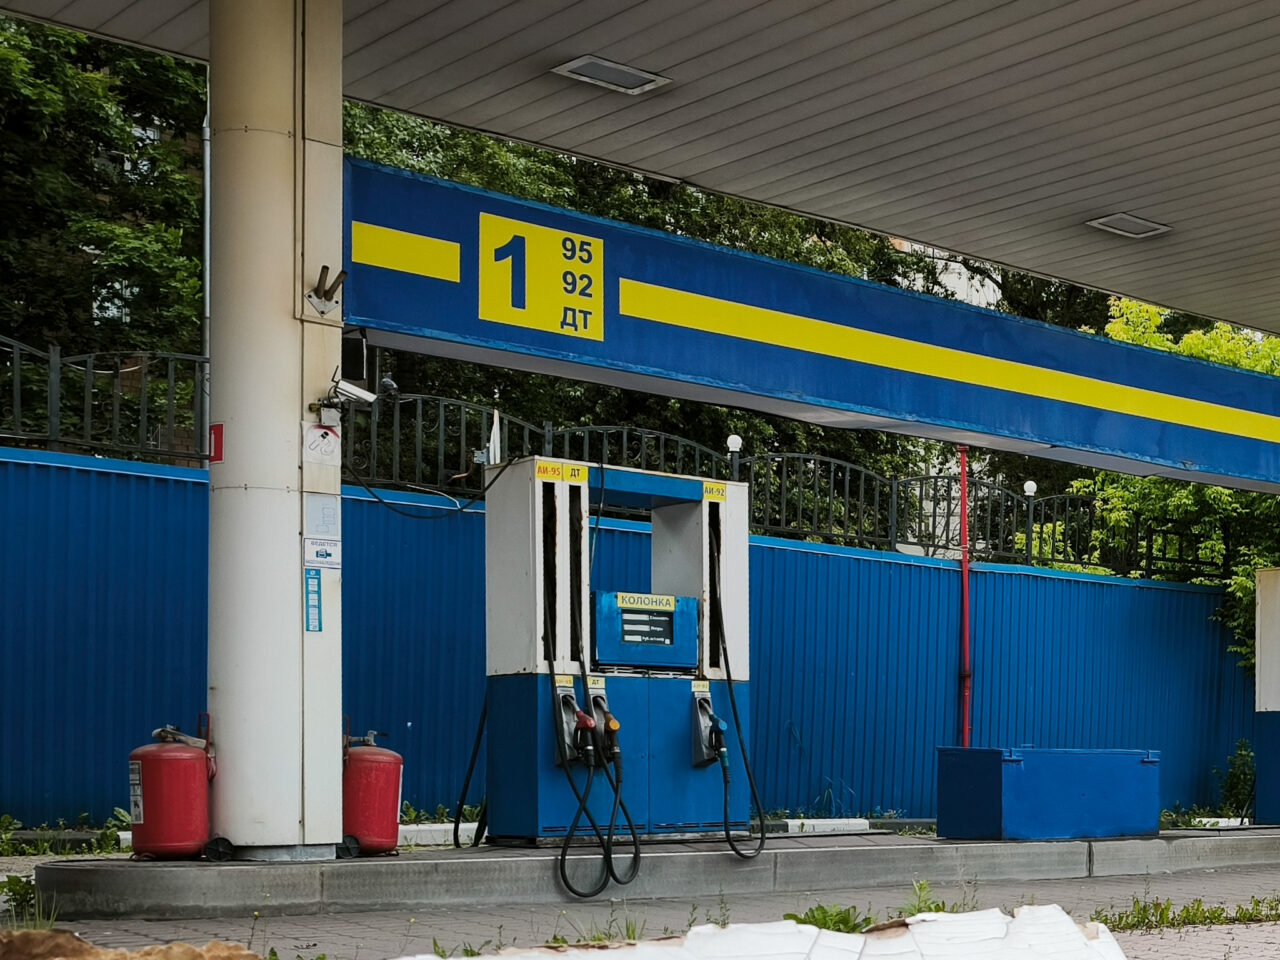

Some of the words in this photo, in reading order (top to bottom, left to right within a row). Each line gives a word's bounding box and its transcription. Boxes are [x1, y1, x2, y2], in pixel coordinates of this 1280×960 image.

[562, 237, 593, 264] 95
[494, 235, 526, 309] 1
[561, 270, 593, 298] 92
[560, 306, 593, 332] ДТ
[570, 468, 581, 479] ДТ
[704, 485, 725, 497] АИ-92
[621, 595, 671, 607] КОЛОНКА
